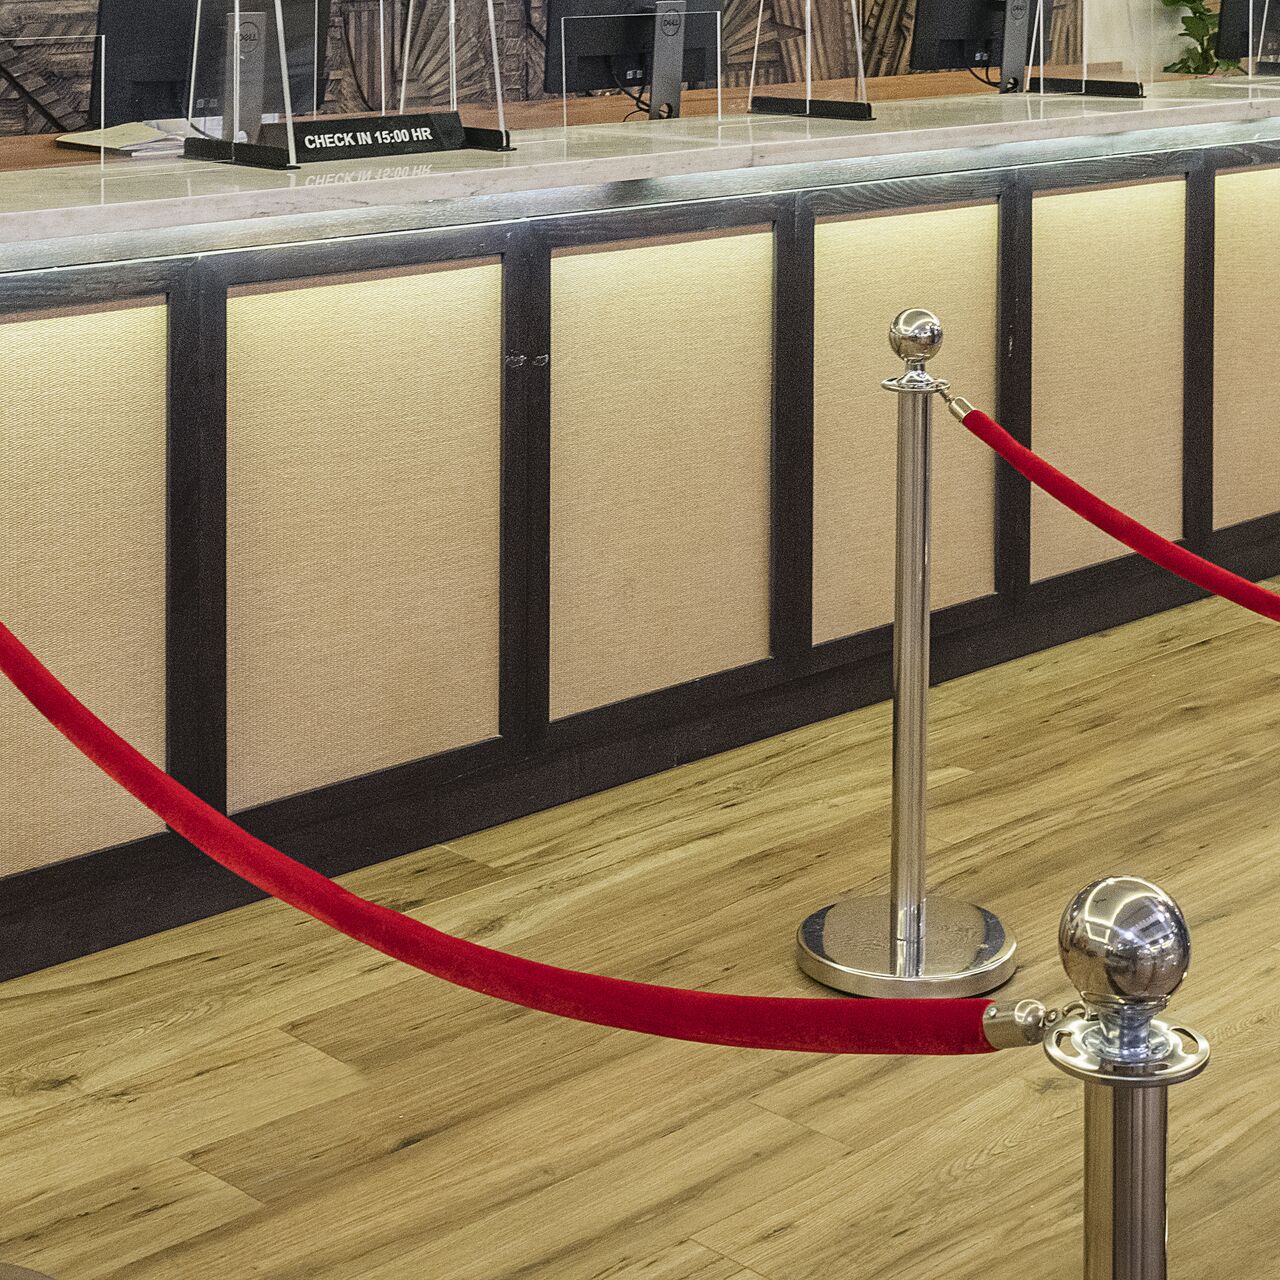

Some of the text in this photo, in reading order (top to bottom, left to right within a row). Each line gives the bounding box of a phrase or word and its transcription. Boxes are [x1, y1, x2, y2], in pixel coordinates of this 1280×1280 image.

[304, 127, 433, 149] CHECK IN 15:00 HR
